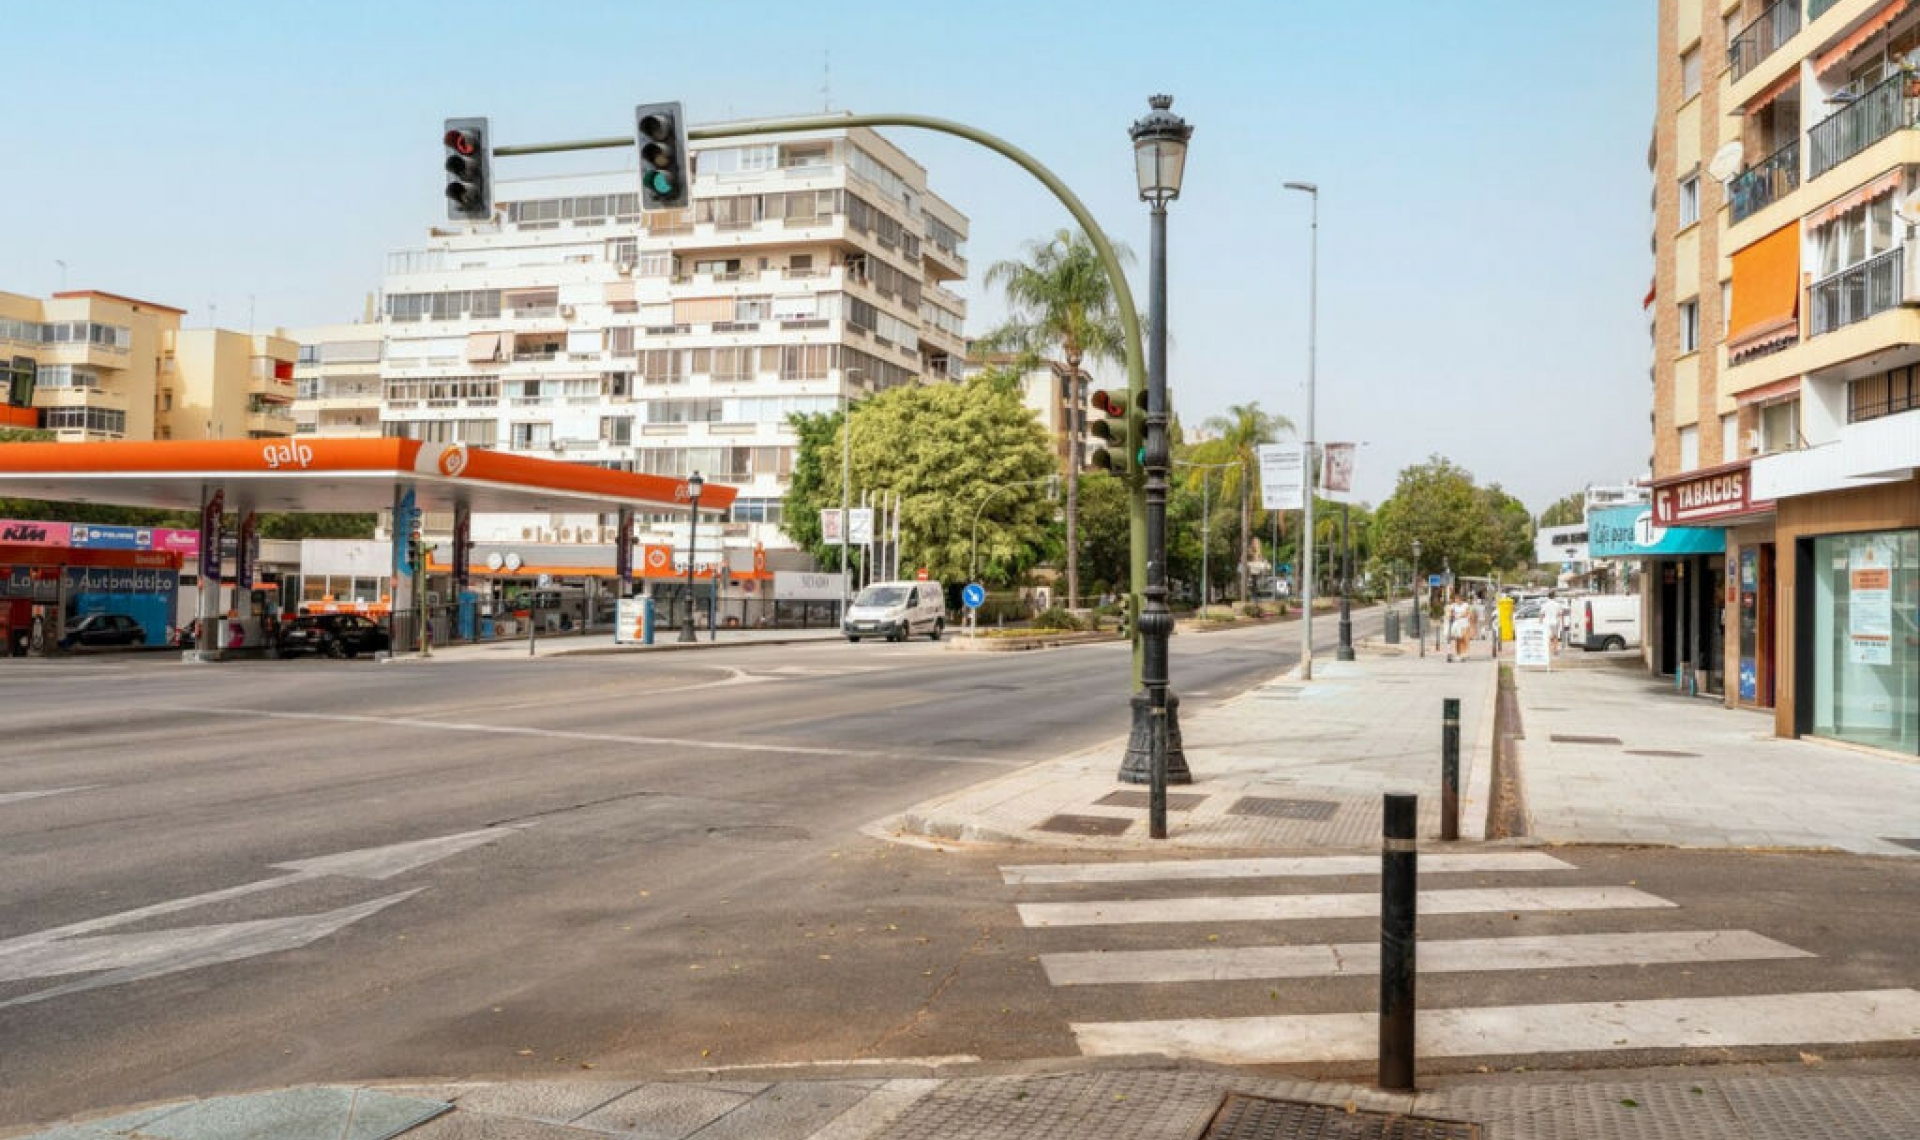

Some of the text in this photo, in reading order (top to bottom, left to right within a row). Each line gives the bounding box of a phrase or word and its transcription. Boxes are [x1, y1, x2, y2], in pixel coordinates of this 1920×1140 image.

[263, 438, 313, 468] galp
[1677, 475, 1742, 509] TABACOS
[2, 525, 47, 541] KTM
